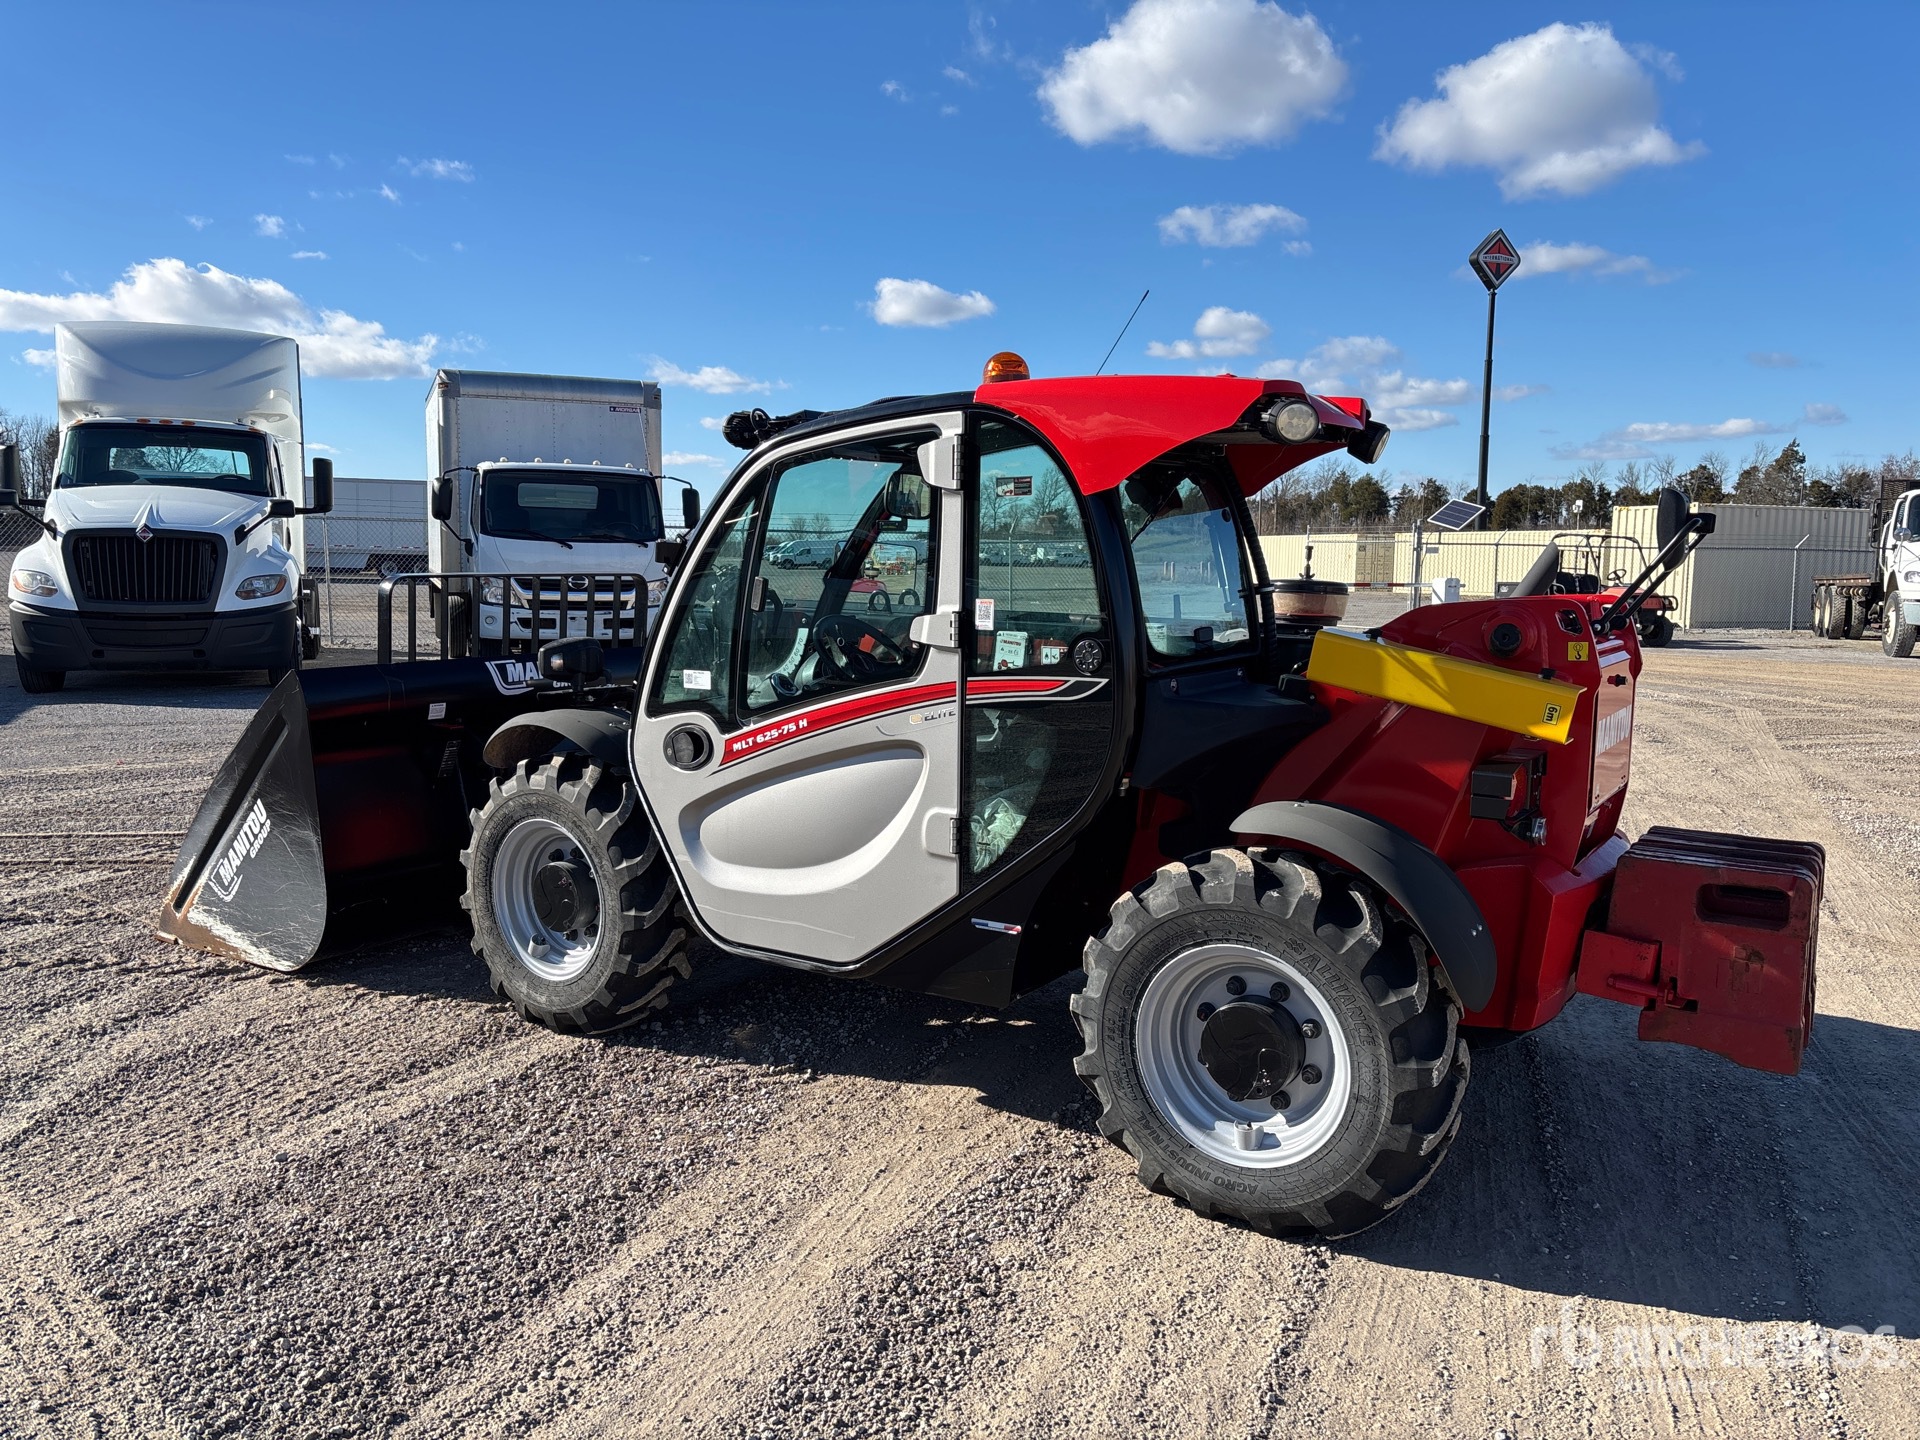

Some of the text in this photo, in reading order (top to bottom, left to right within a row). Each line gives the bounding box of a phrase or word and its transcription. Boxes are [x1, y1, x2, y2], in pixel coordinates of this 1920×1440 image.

[732, 718, 808, 752] MLT 625-75 H
[924, 707, 956, 721] ELITE
[1596, 704, 1632, 757] MANITOU
[218, 798, 268, 887] MANITOU
[249, 818, 272, 859] GROUP
[1299, 953, 1378, 1047] ALLIANCE
[1136, 1110, 1212, 1181] INDUSTRIAL
[1213, 1176, 1259, 1195] AGRO
